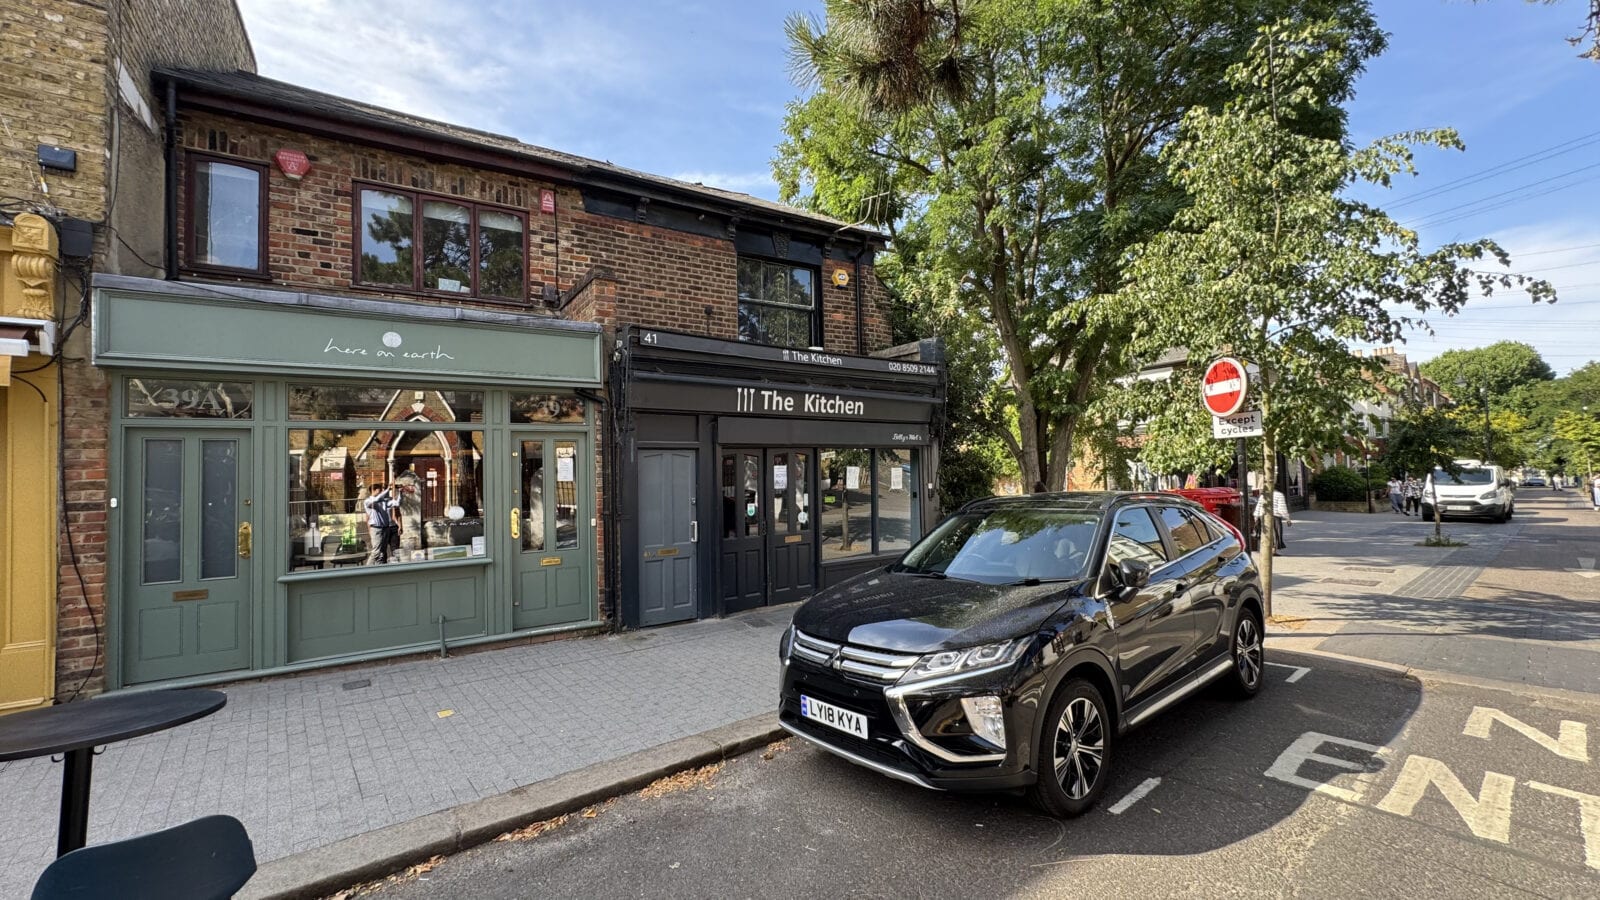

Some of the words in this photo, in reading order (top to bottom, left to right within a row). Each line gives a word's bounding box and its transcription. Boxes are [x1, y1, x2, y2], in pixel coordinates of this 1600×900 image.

[643, 333, 658, 345] 41
[323, 337, 368, 355] here
[376, 350, 396, 358] on
[403, 344, 455, 360] earth
[791, 350, 809, 362] The
[811, 353, 843, 366] Kitchen
[888, 362, 901, 371] 020
[902, 363, 918, 373] 8509
[919, 365, 935, 374] 2144
[162, 388, 222, 410] 39A
[760, 389, 794, 412] The
[804, 393, 864, 415] Kitchen
[1219, 415, 1255, 425] Except
[1221, 426, 1254, 435] cycles
[808, 699, 835, 723] LY18
[837, 709, 862, 734] KYA
